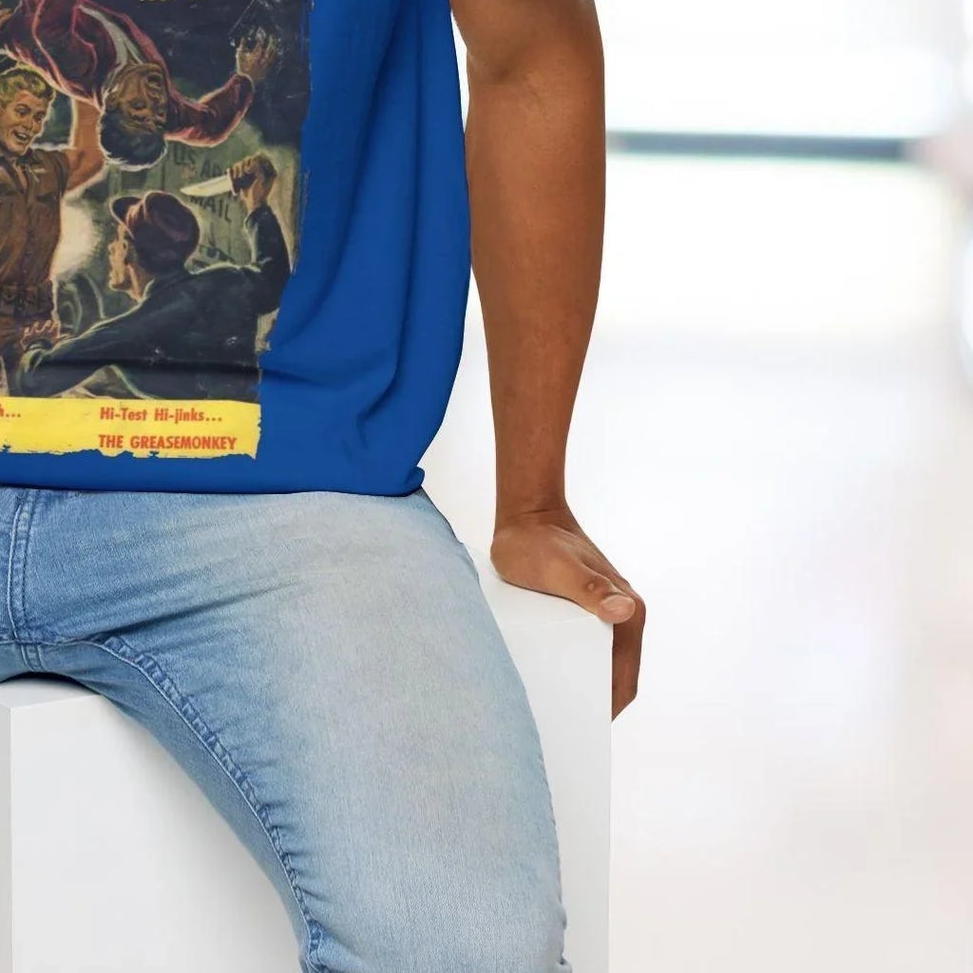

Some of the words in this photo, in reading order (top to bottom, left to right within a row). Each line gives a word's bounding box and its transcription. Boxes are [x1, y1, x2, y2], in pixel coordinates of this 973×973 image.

[99, 407, 148, 421] Hi-Test
[154, 407, 223, 424] Hi-jinks...
[98, 434, 124, 449] THE
[130, 435, 237, 450] GREASEMONKEY
